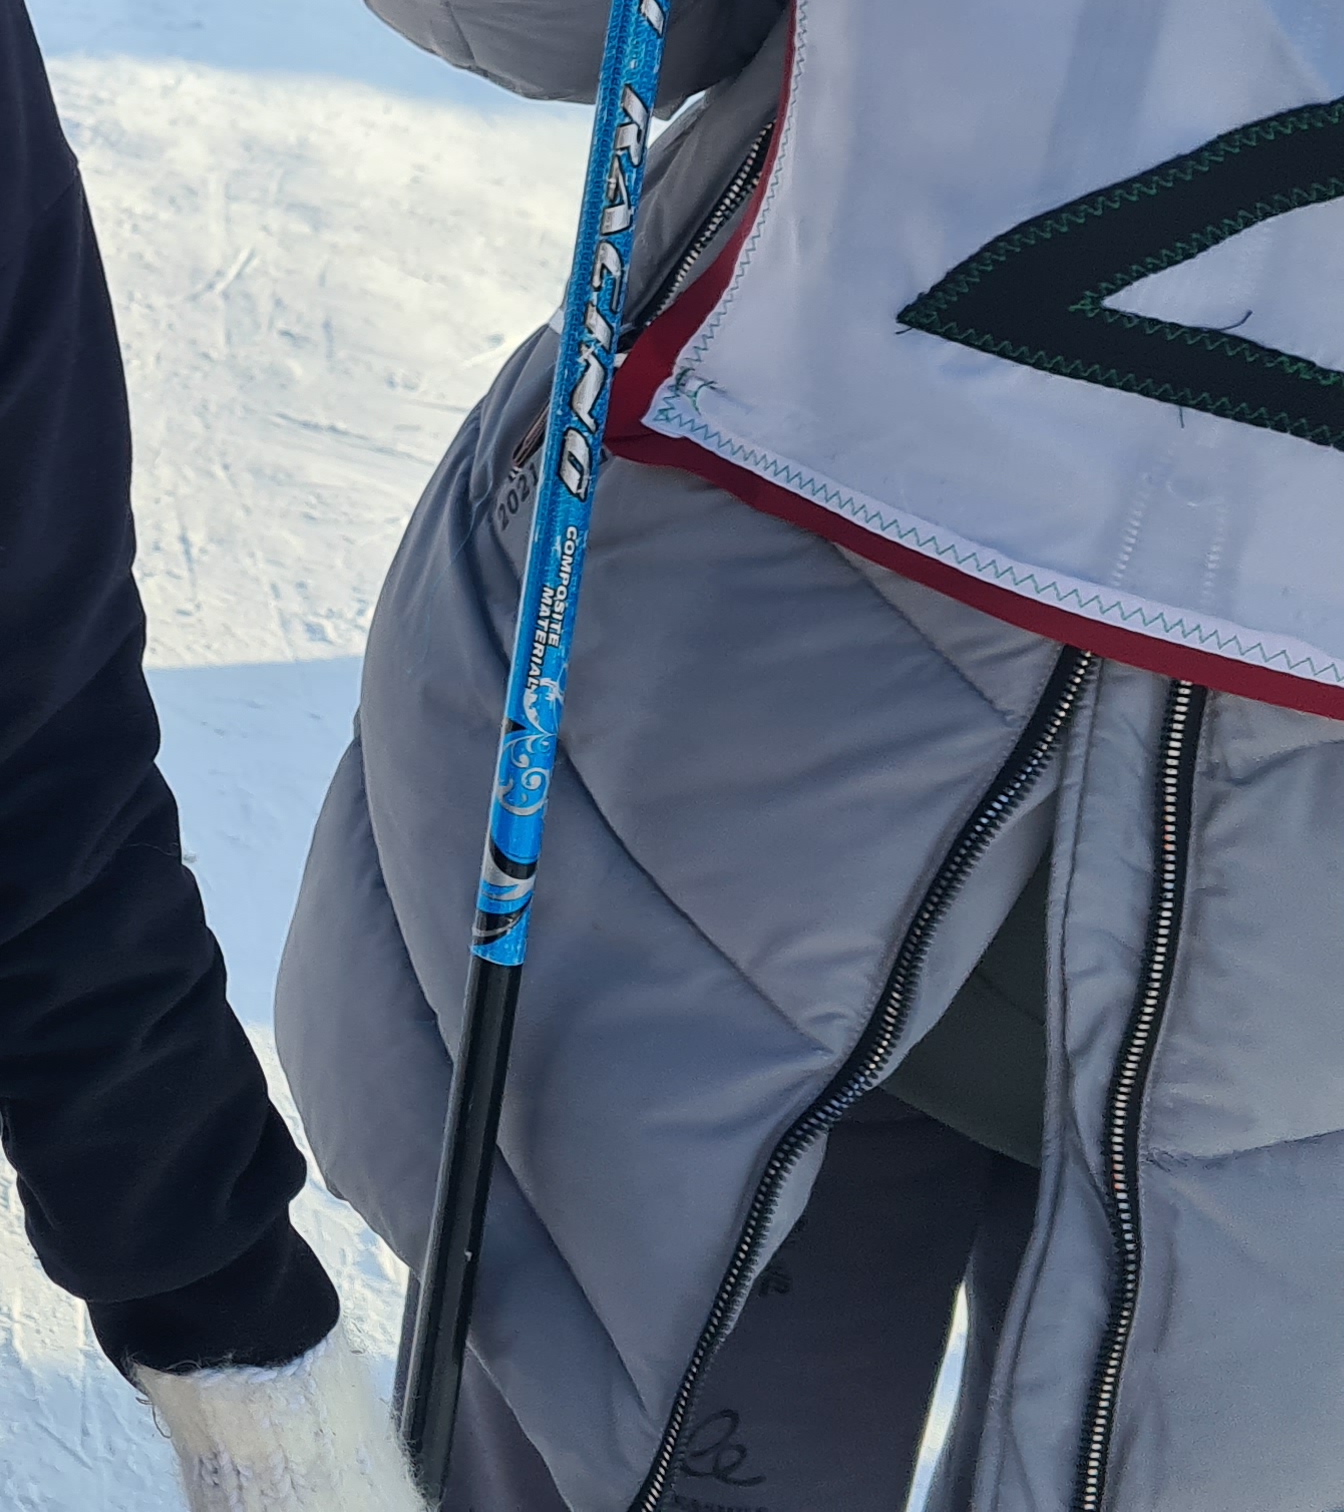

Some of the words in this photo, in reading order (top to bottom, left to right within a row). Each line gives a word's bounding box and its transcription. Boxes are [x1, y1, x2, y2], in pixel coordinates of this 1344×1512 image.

[558, 82, 651, 503] RACING
[524, 584, 555, 690] MATERIAL
[548, 525, 578, 648] COMPOSITE
